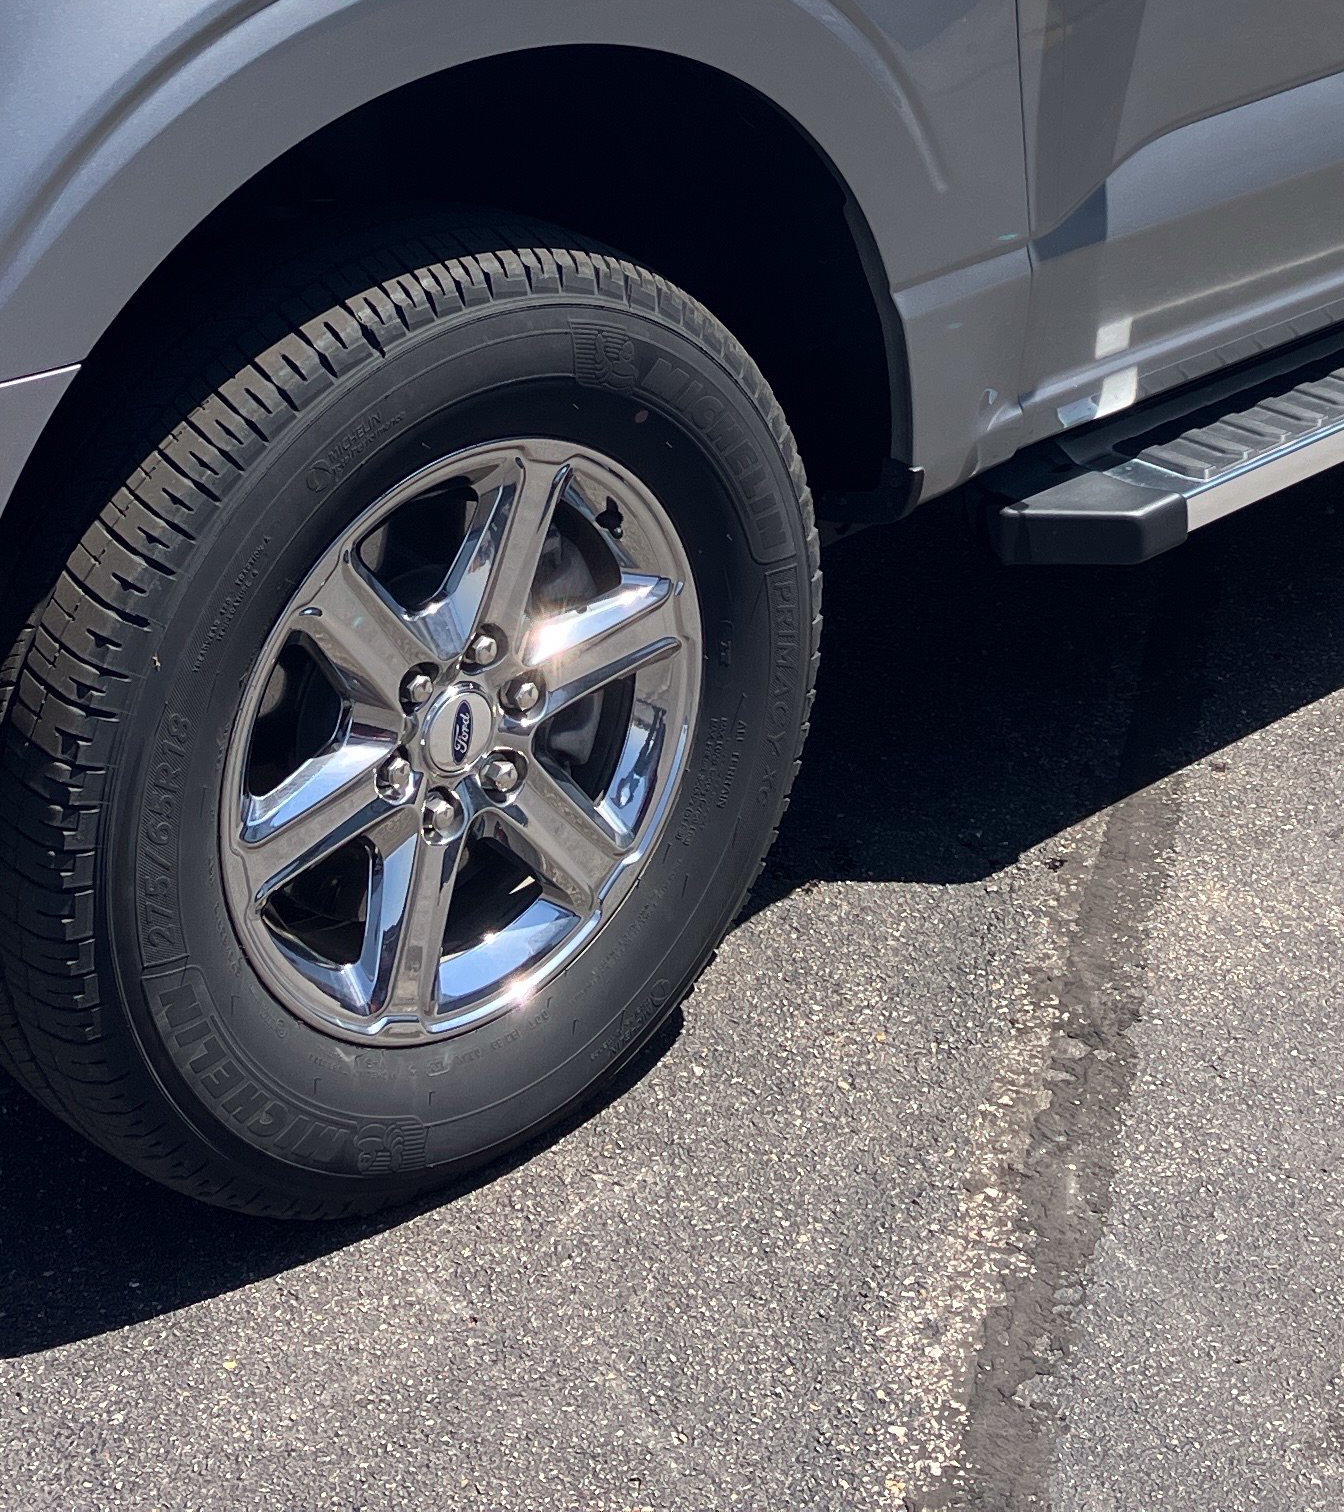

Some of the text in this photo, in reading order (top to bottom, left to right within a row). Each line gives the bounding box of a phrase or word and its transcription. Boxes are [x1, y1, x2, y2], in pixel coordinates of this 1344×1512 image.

[327, 410, 382, 463] MICHELIN
[640, 356, 788, 551] MICHELIN
[453, 711, 471, 754] Ford
[767, 580, 799, 758] PRIMACY
[144, 711, 193, 951] 275/65R18
[158, 982, 353, 1163] MICHELIN
